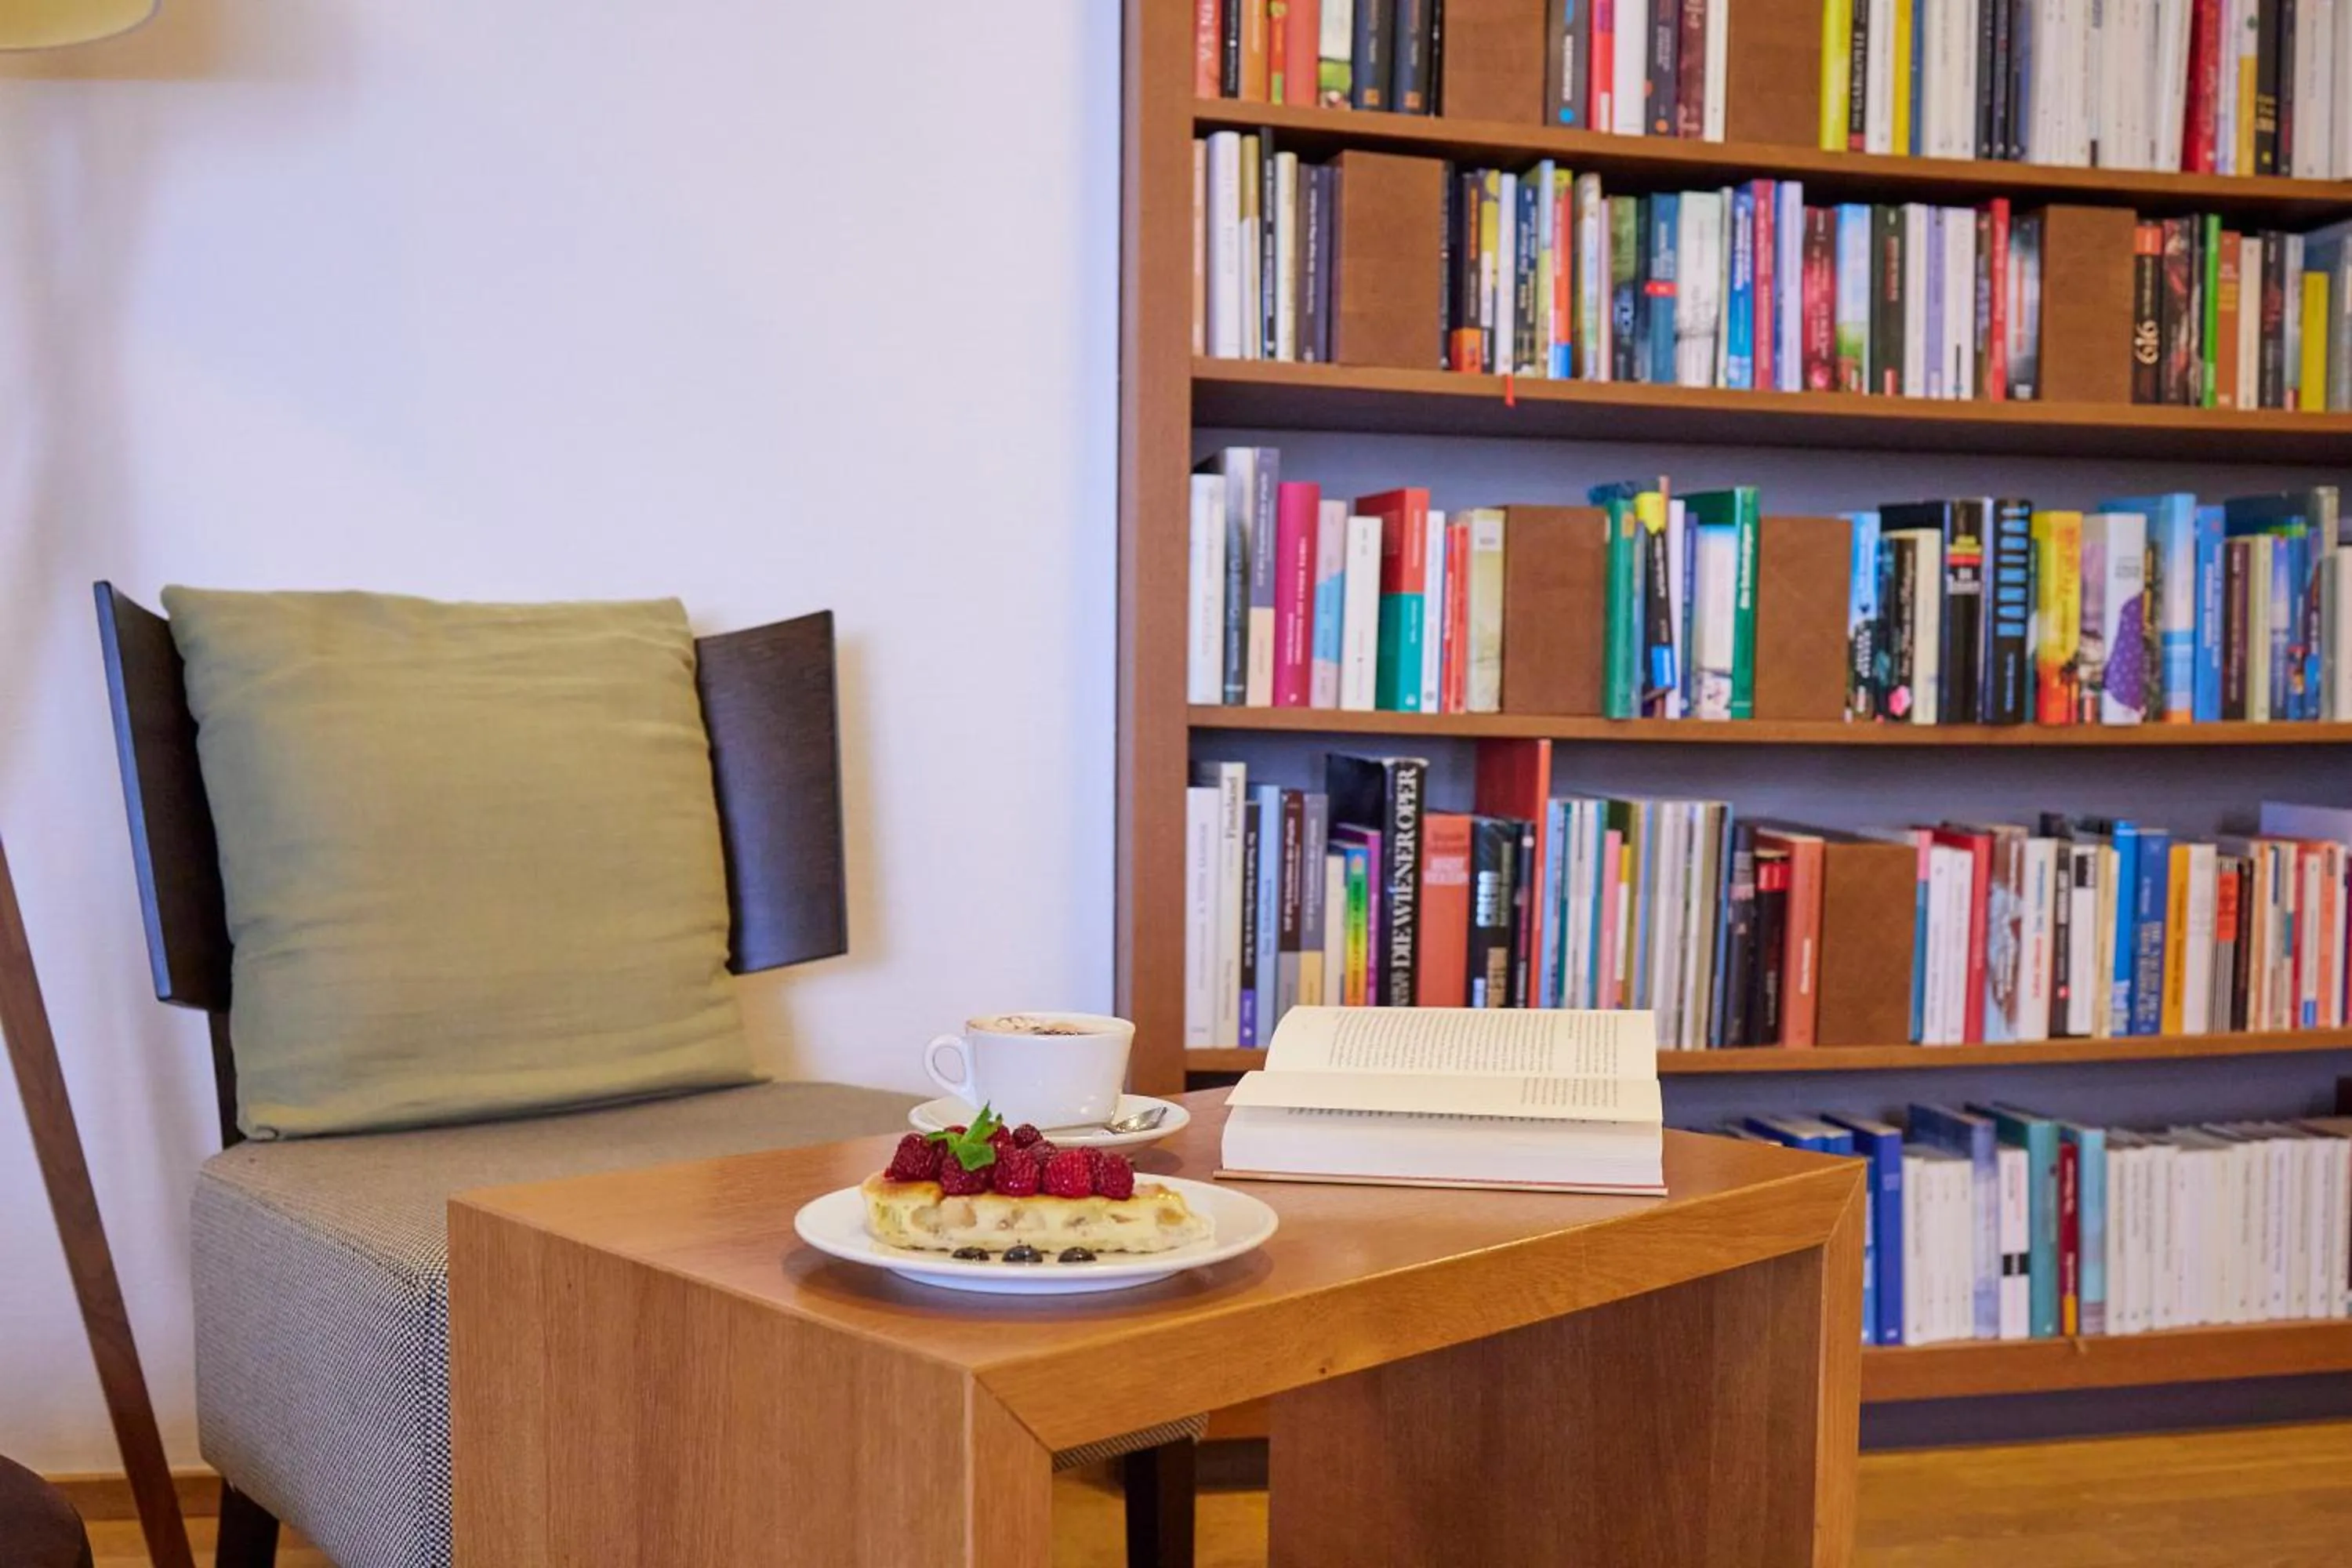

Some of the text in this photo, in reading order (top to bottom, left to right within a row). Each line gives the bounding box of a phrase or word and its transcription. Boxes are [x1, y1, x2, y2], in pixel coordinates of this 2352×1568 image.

[1396, 767, 1417, 831] OPER
[1392, 831, 1415, 928] WIENER
[1390, 929, 1412, 967] DIE
